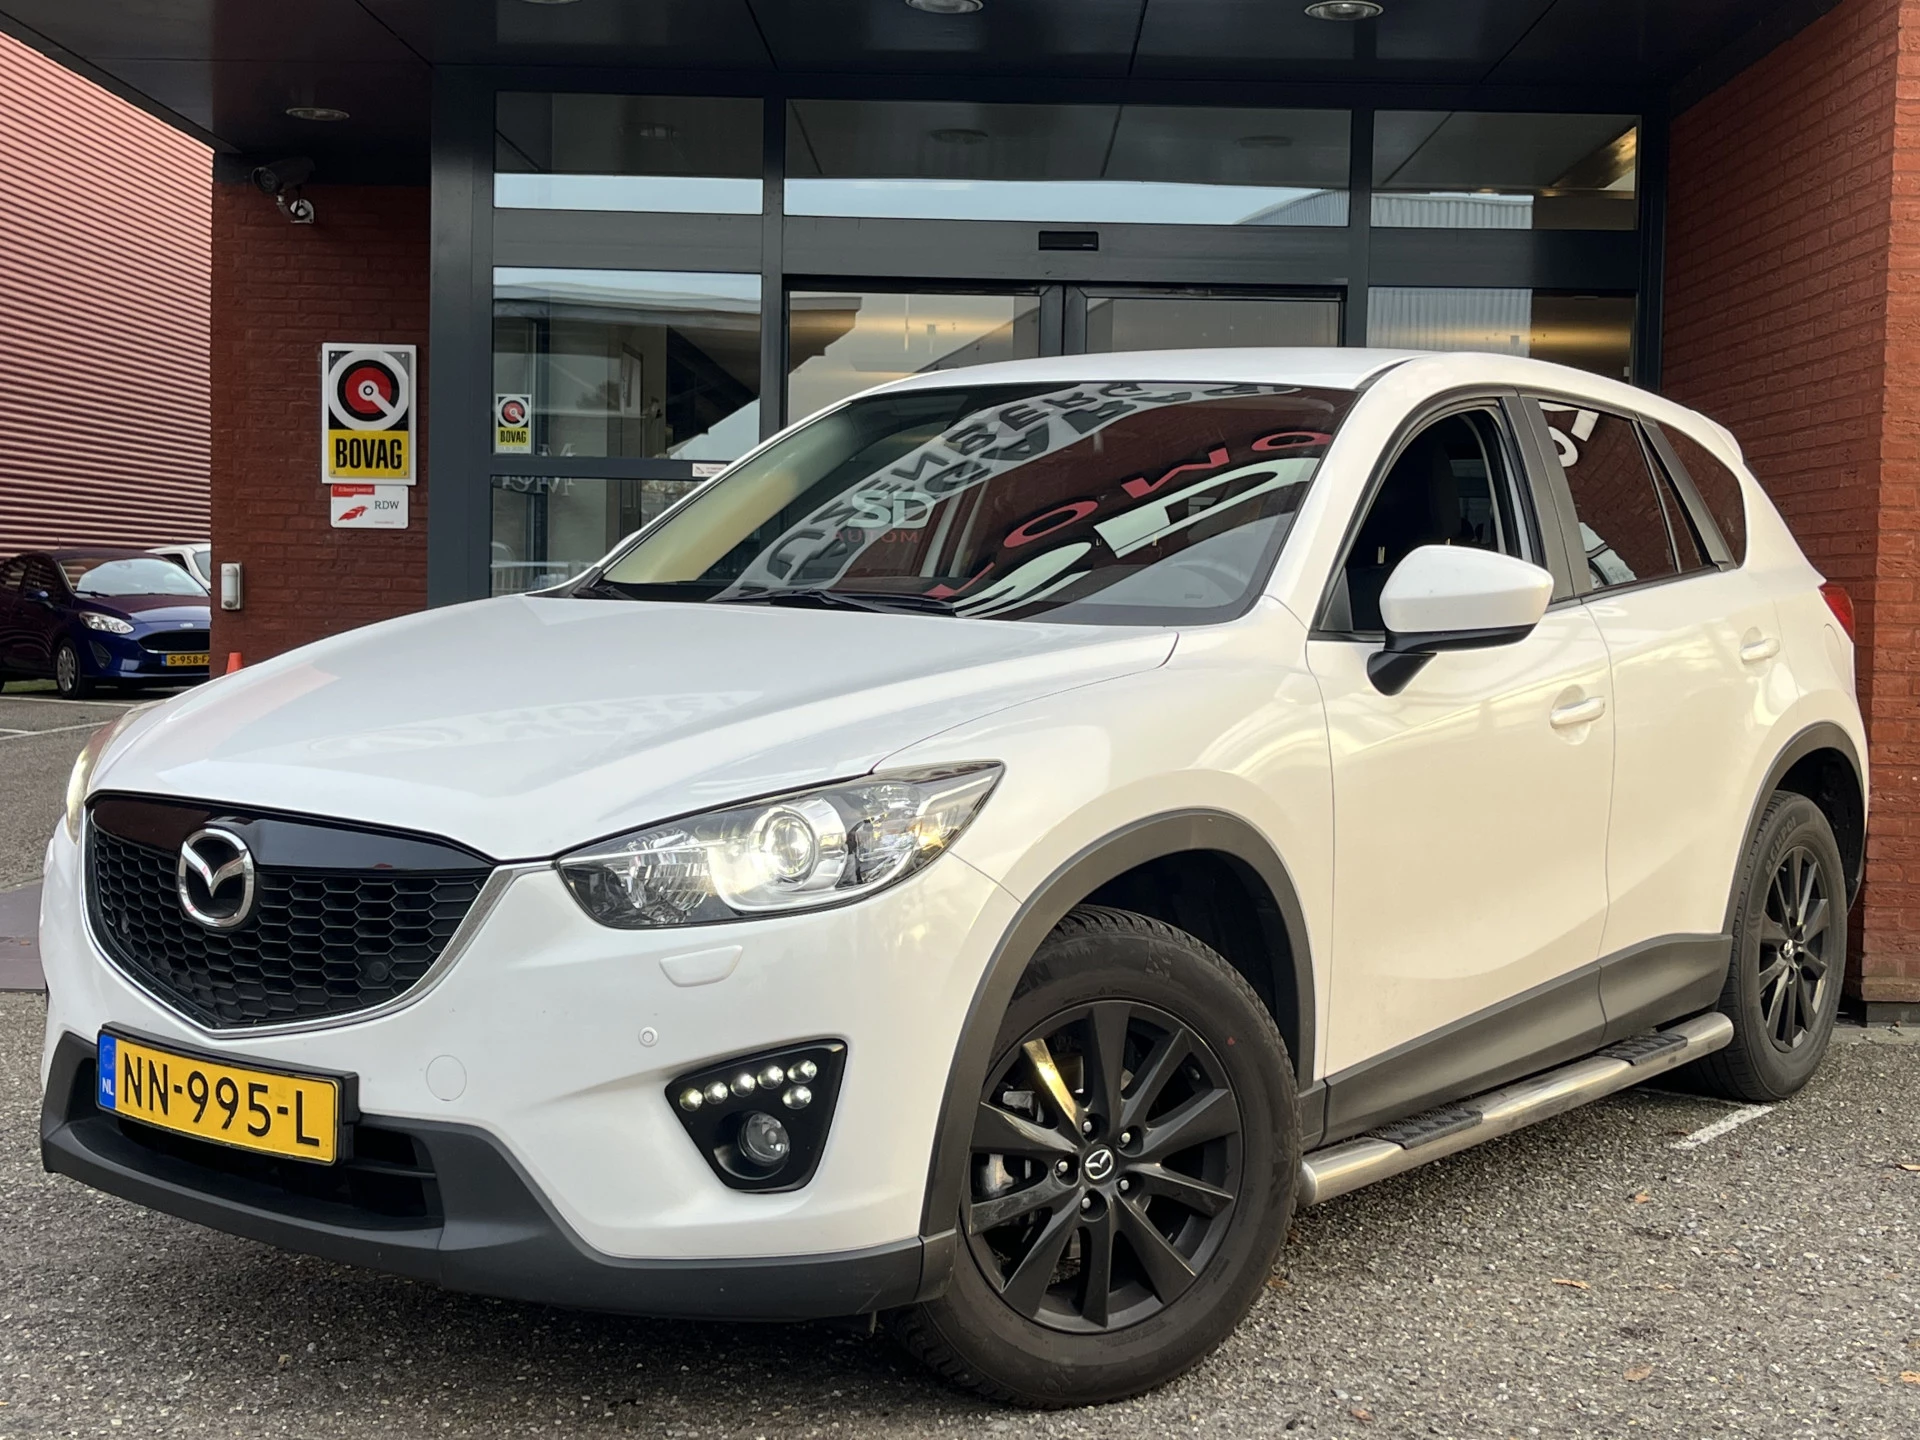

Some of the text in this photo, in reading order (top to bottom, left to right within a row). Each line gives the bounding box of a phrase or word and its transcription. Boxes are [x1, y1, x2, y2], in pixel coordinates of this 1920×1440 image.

[500, 430, 527, 443] BOVAG
[335, 438, 402, 469] BOVAG
[374, 500, 400, 510] RDW
[102, 1077, 114, 1096] NL
[124, 1052, 320, 1147] NN-995-L
